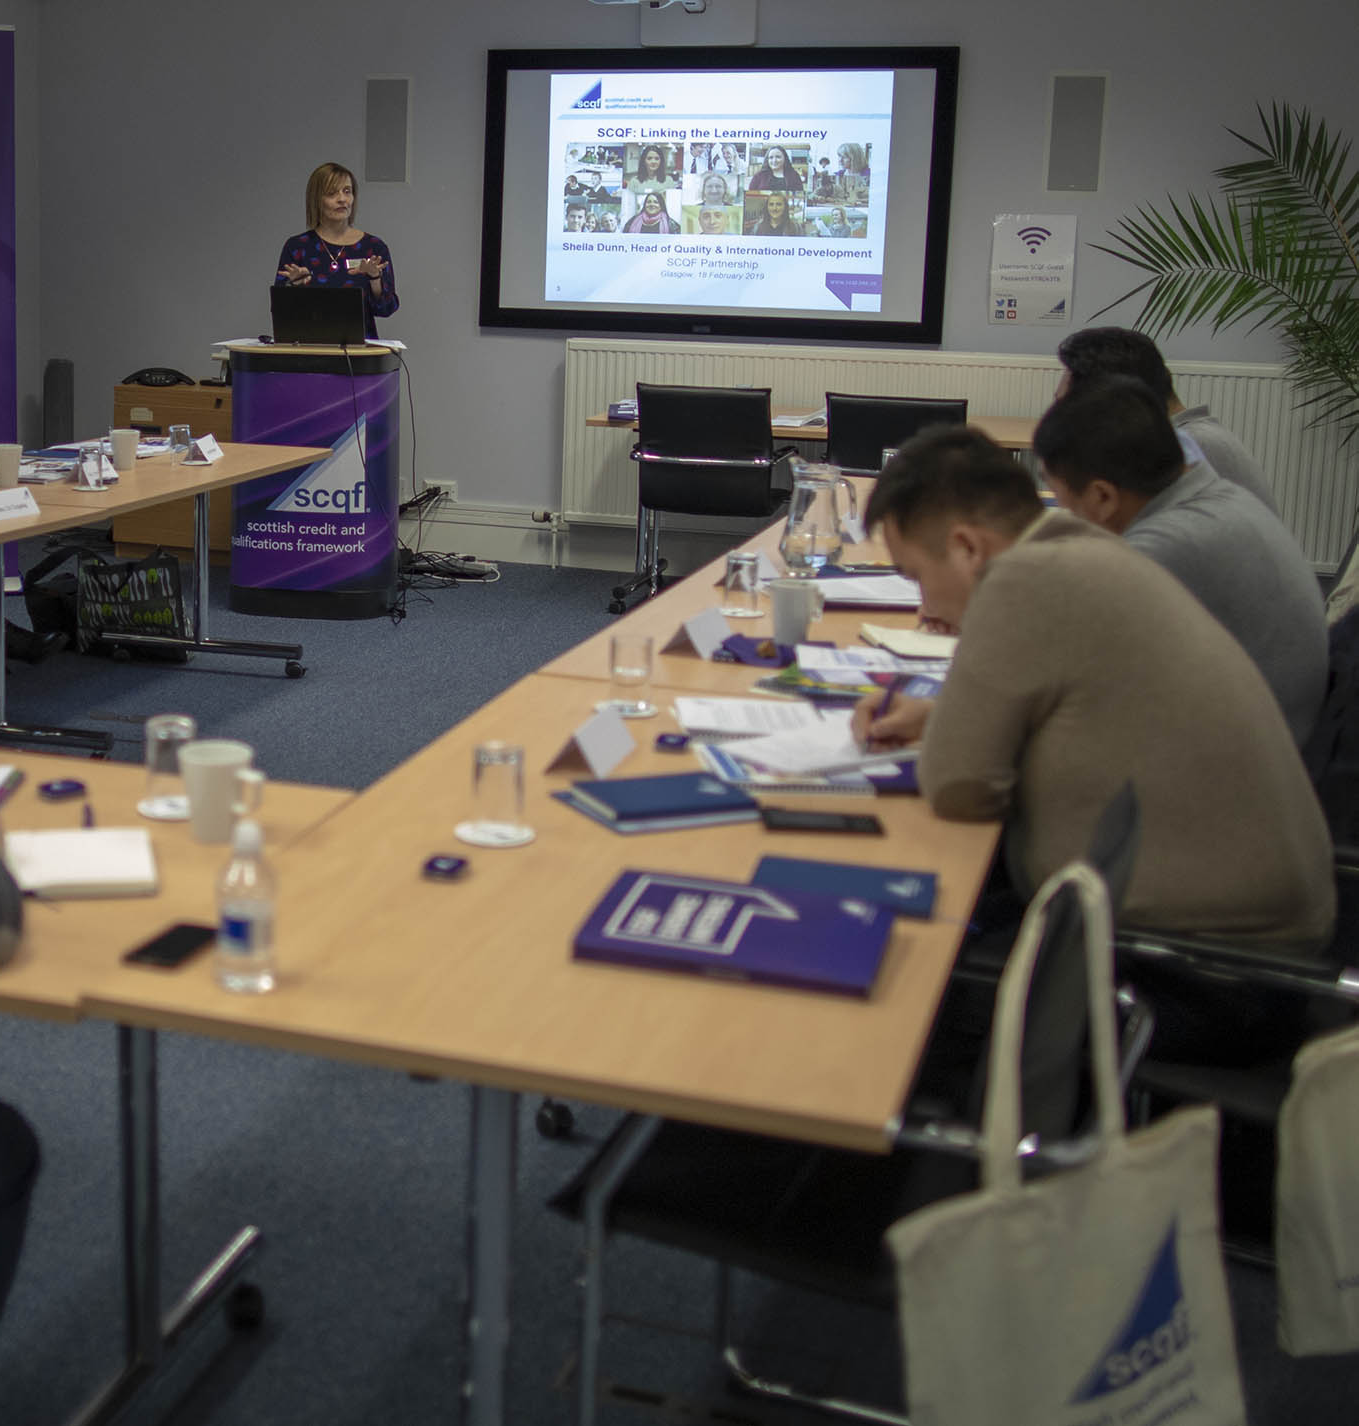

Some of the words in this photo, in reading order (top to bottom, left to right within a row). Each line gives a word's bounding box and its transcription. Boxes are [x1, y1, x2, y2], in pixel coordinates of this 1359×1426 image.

[577, 98, 601, 109] scqf
[597, 128, 637, 138] SCQF:
[641, 128, 686, 140] Linking
[690, 128, 710, 138] the
[714, 128, 771, 140] Learning
[774, 128, 828, 140] Journey
[597, 243, 628, 253] Dunn,
[631, 243, 658, 253] Head
[661, 244, 672, 253] of
[674, 245, 712, 255] Quality
[715, 245, 723, 254] &
[726, 246, 795, 256] International
[798, 248, 873, 259] Development
[667, 258, 697, 267] SCQF
[700, 258, 759, 270] Partnership
[708, 271, 744, 280] February
[294, 481, 365, 513] scqf
[246, 521, 295, 534] scottish
[298, 522, 337, 536] credit
[340, 523, 365, 536] and
[296, 539, 365, 553] framework
